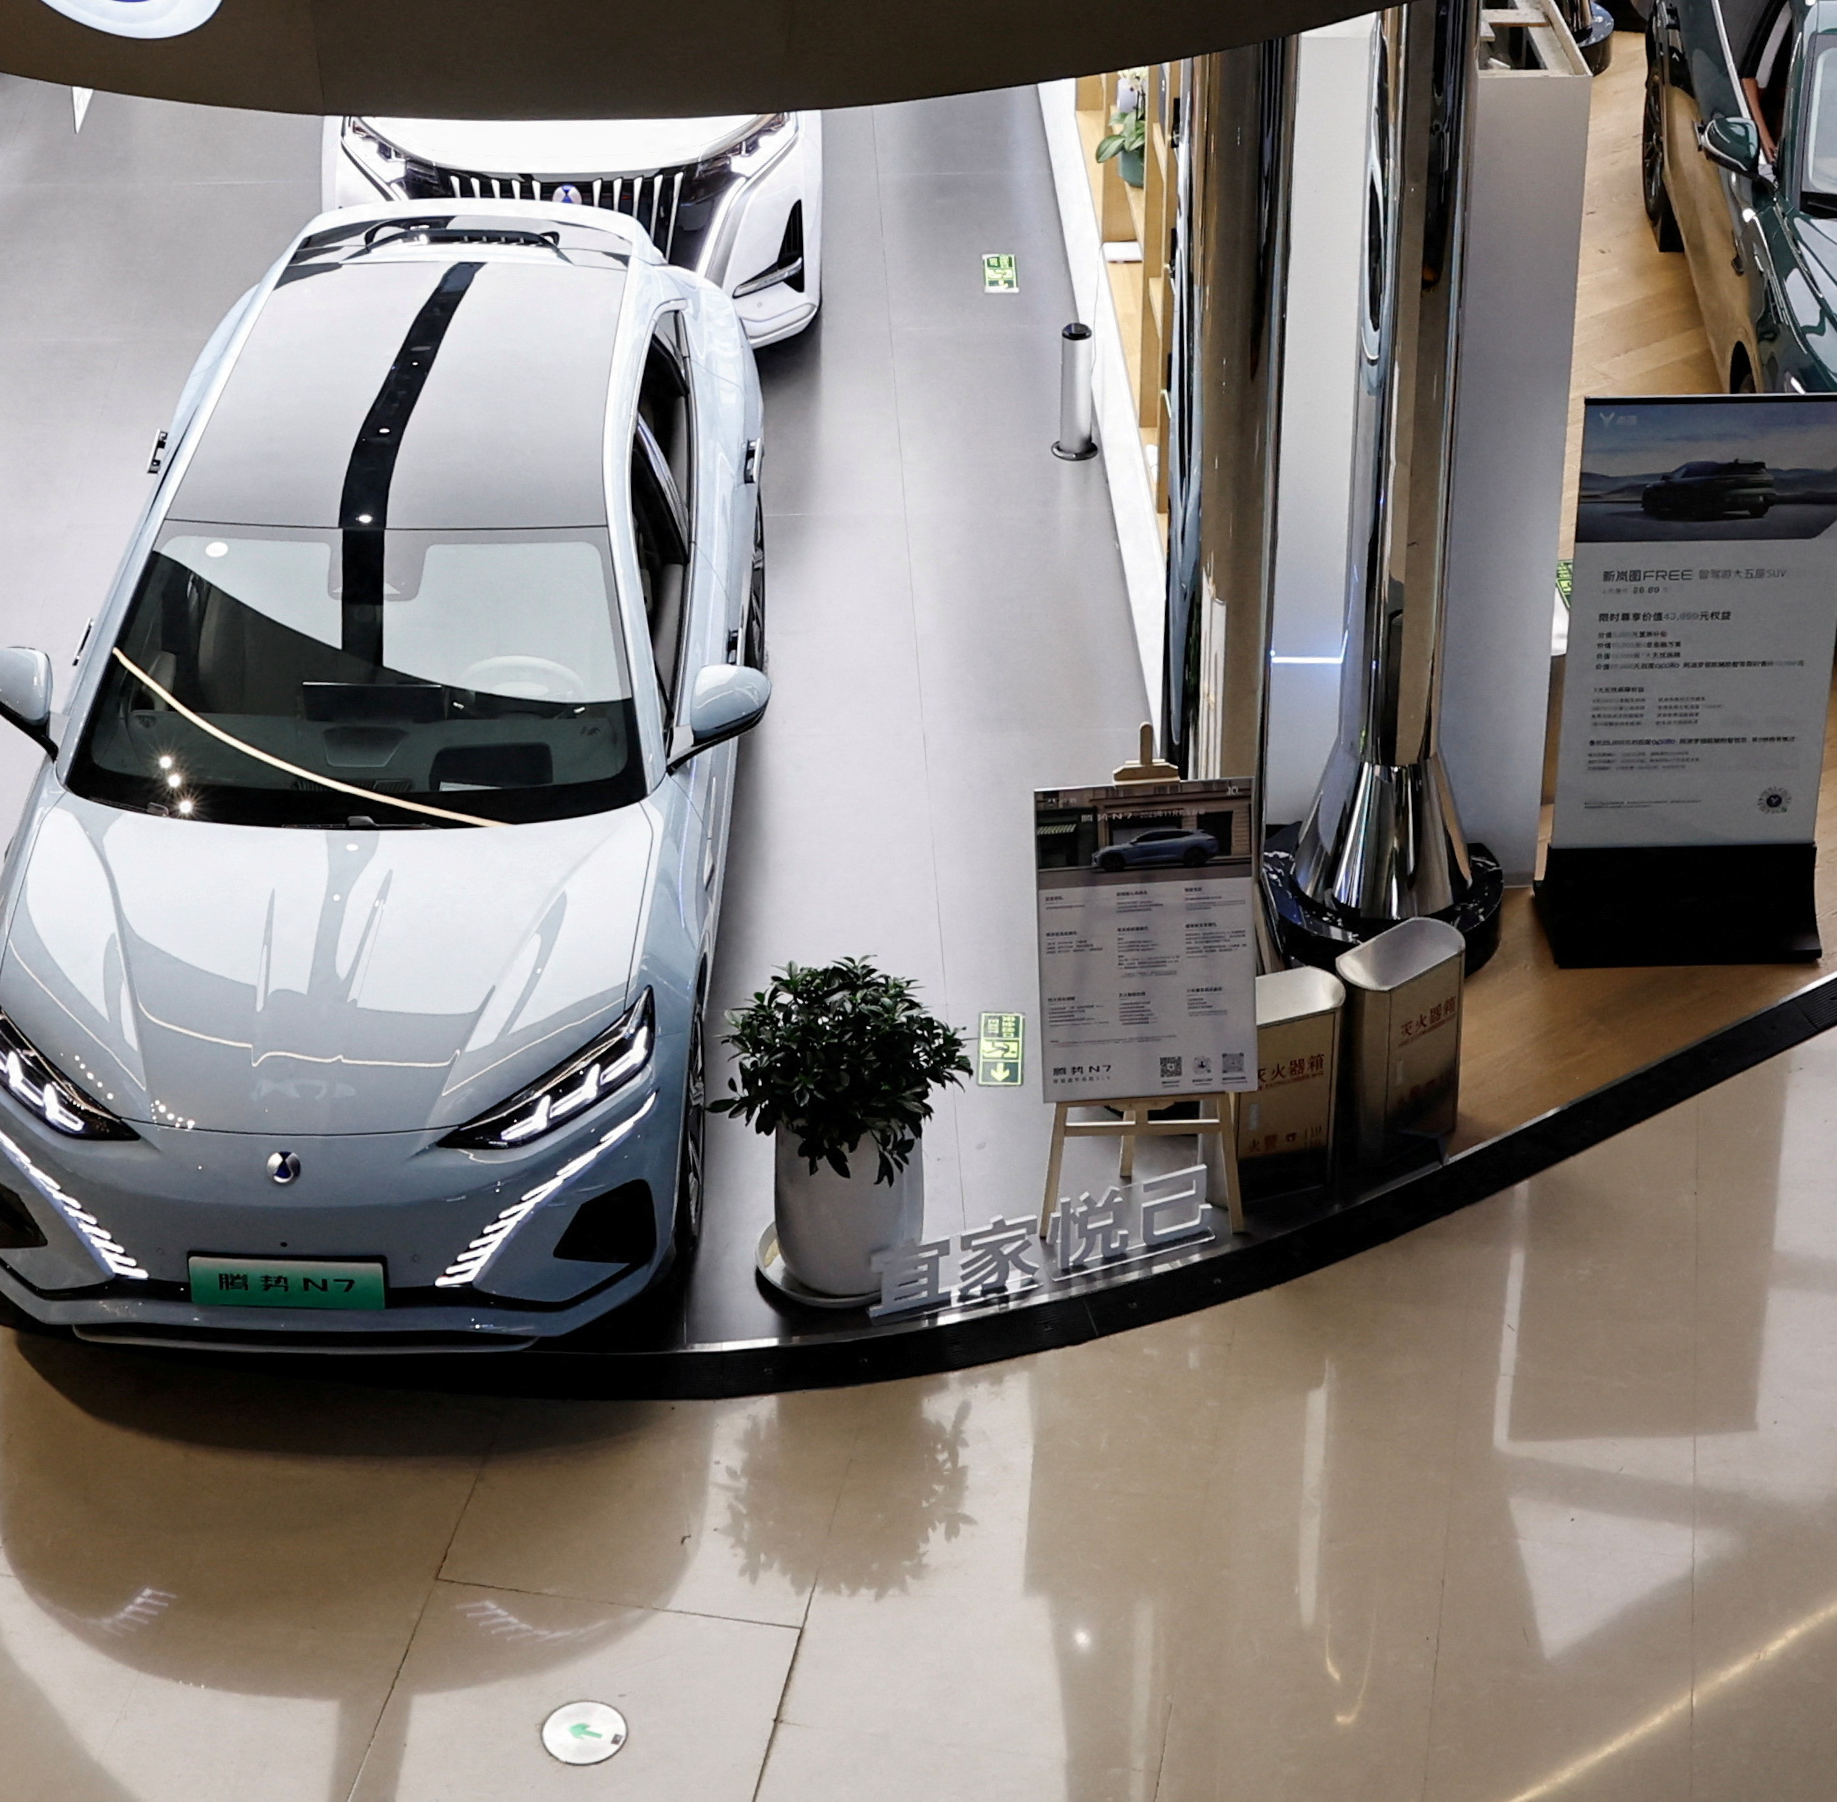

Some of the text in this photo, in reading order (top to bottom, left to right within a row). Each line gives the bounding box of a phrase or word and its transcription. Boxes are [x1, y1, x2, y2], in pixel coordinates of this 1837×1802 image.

[1602, 569, 1694, 582] 新岚图FREE
[1400, 995, 1457, 1037] 灭火器箱
[1053, 1064, 1112, 1077] 腾势N7
[1257, 1053, 1325, 1083] 灭火器箱
[867, 1164, 1213, 1319] 宜家悦己
[217, 1272, 356, 1294] 腾势N7
